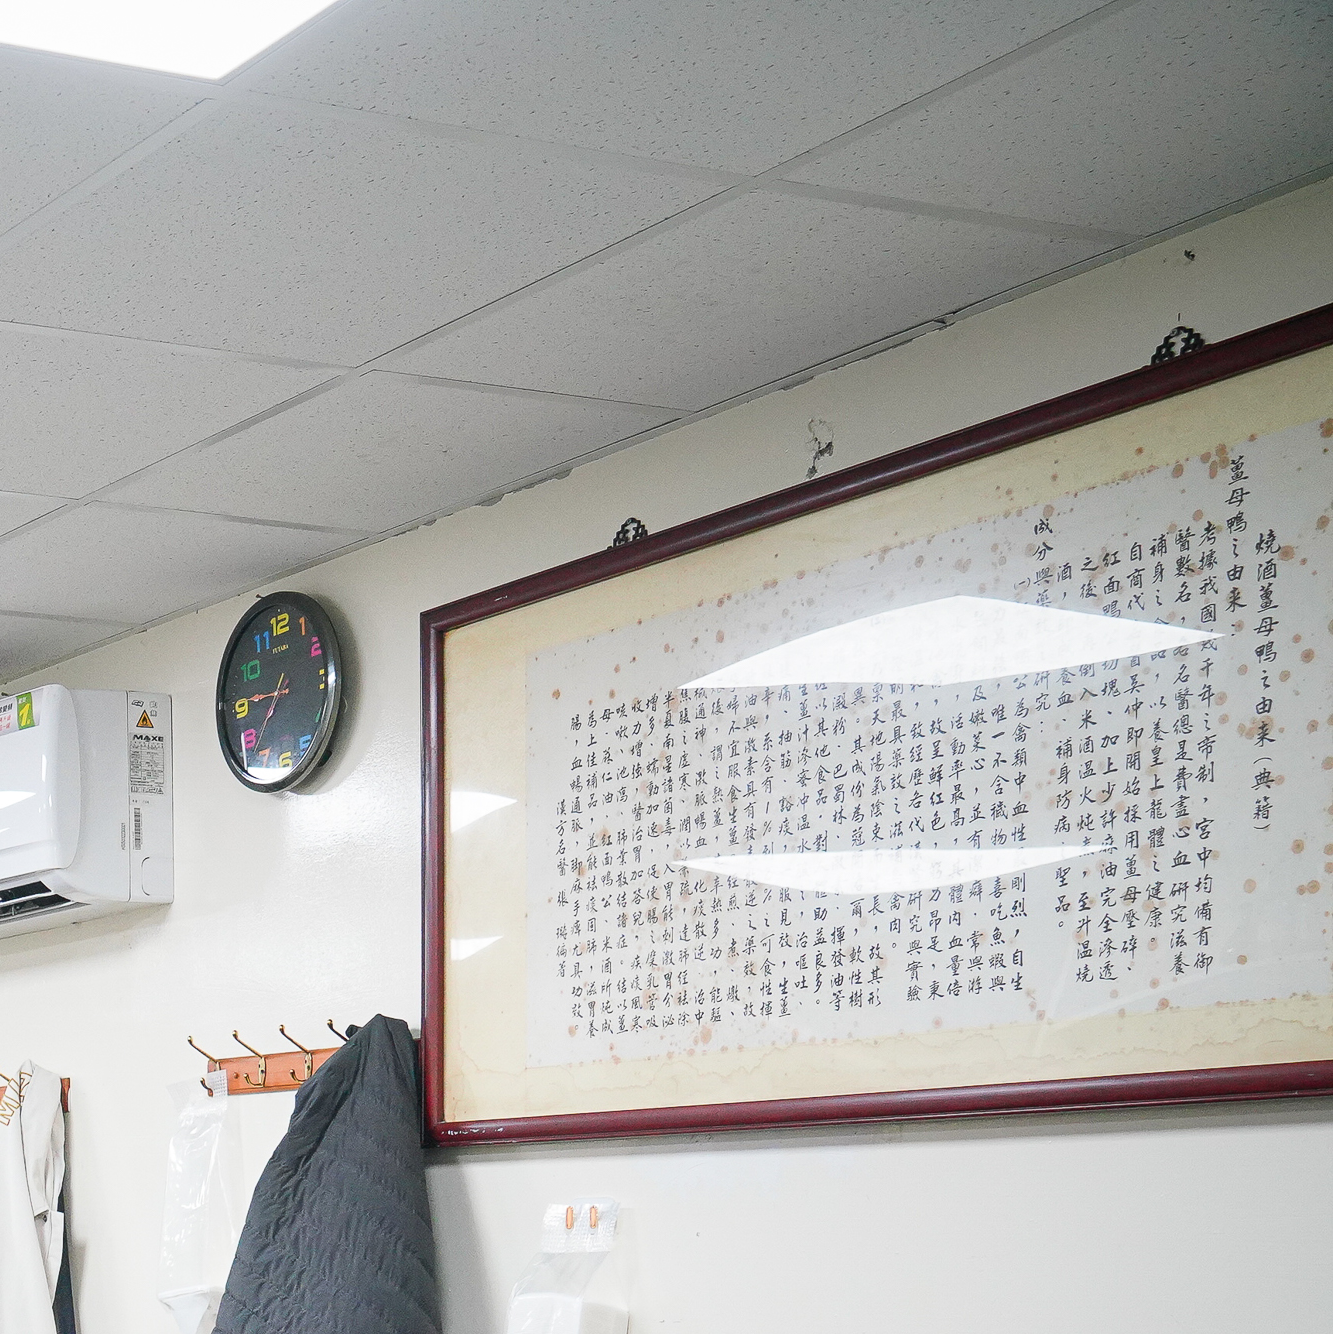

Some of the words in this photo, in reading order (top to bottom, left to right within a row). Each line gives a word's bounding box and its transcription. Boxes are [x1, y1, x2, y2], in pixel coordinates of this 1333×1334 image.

[270, 613, 290, 637] 12
[298, 616, 307, 636] 1
[253, 631, 270, 653] 11
[240, 659, 261, 682] 10
[235, 698, 249, 719] 9
[134, 734, 164, 743] MAXE
[243, 728, 256, 749] 8
[258, 748, 271, 768] 7
